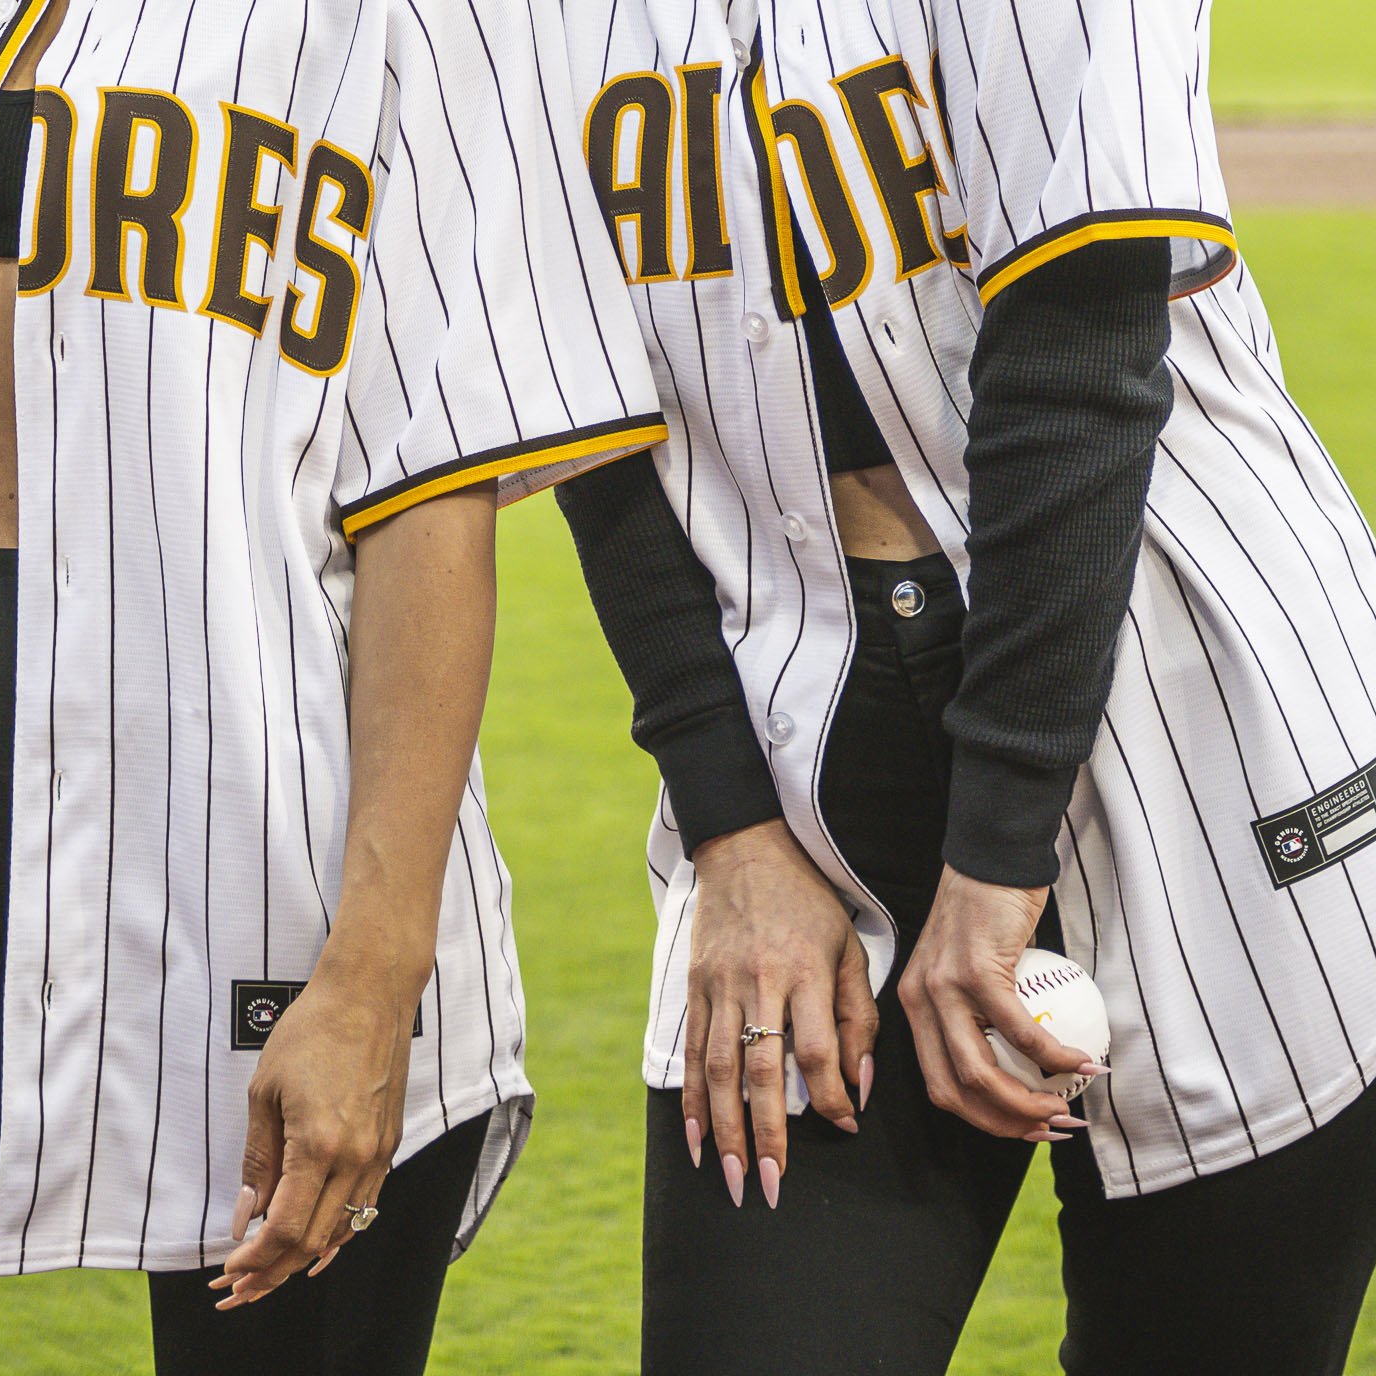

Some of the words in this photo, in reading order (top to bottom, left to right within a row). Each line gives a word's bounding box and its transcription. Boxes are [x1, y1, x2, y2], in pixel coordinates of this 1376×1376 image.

[1311, 780, 1366, 817] ENGINEERED
[1274, 827, 1304, 846] GENUINE
[247, 998, 280, 1011] GENUINE
